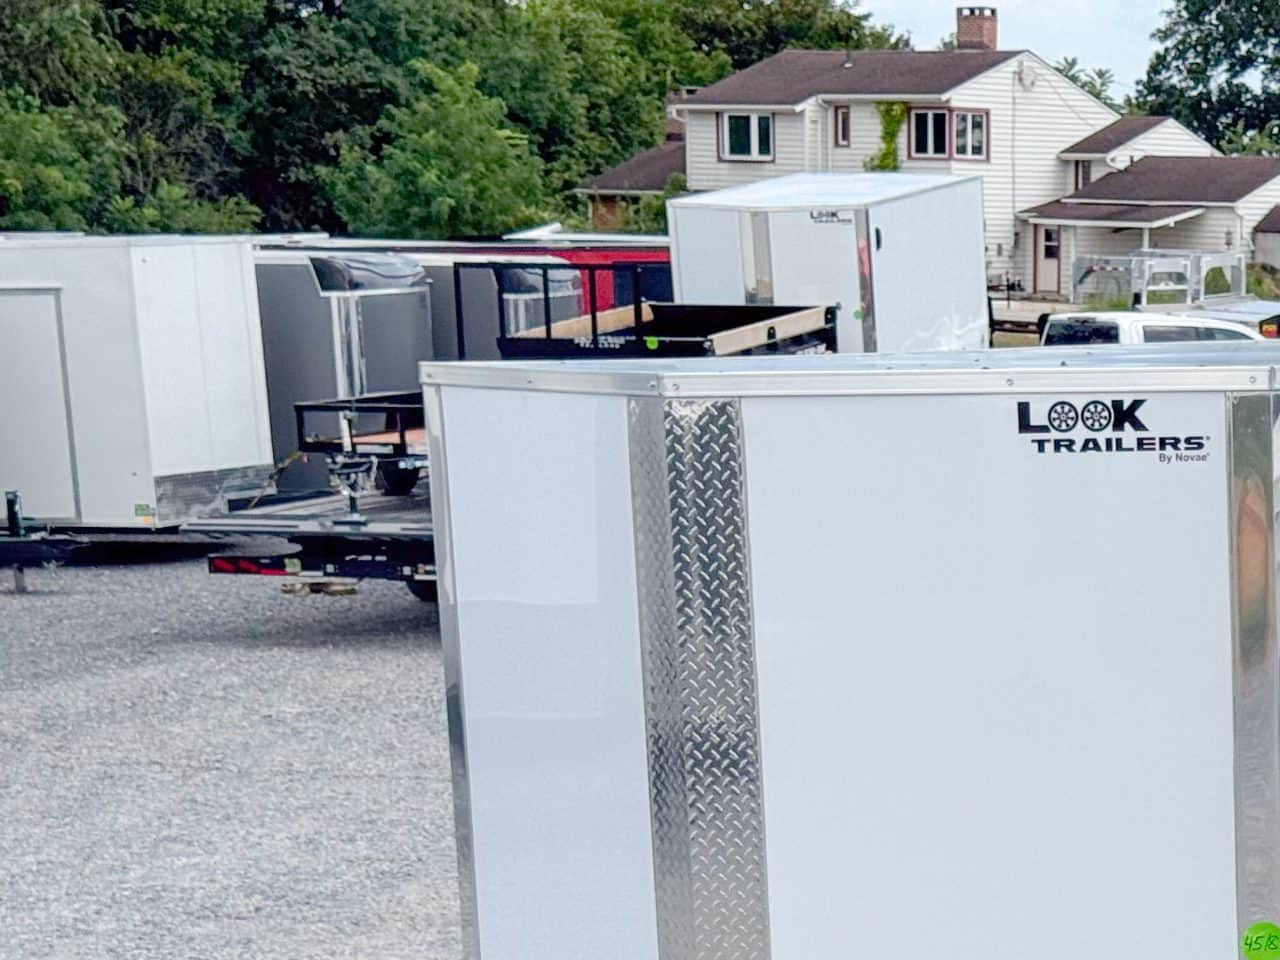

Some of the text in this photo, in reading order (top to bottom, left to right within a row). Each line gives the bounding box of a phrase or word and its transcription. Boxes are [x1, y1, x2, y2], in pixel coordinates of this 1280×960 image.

[1017, 399, 1149, 434] LOOK
[1031, 436, 1206, 453] TRAILERS
[1159, 453, 1172, 464] By
